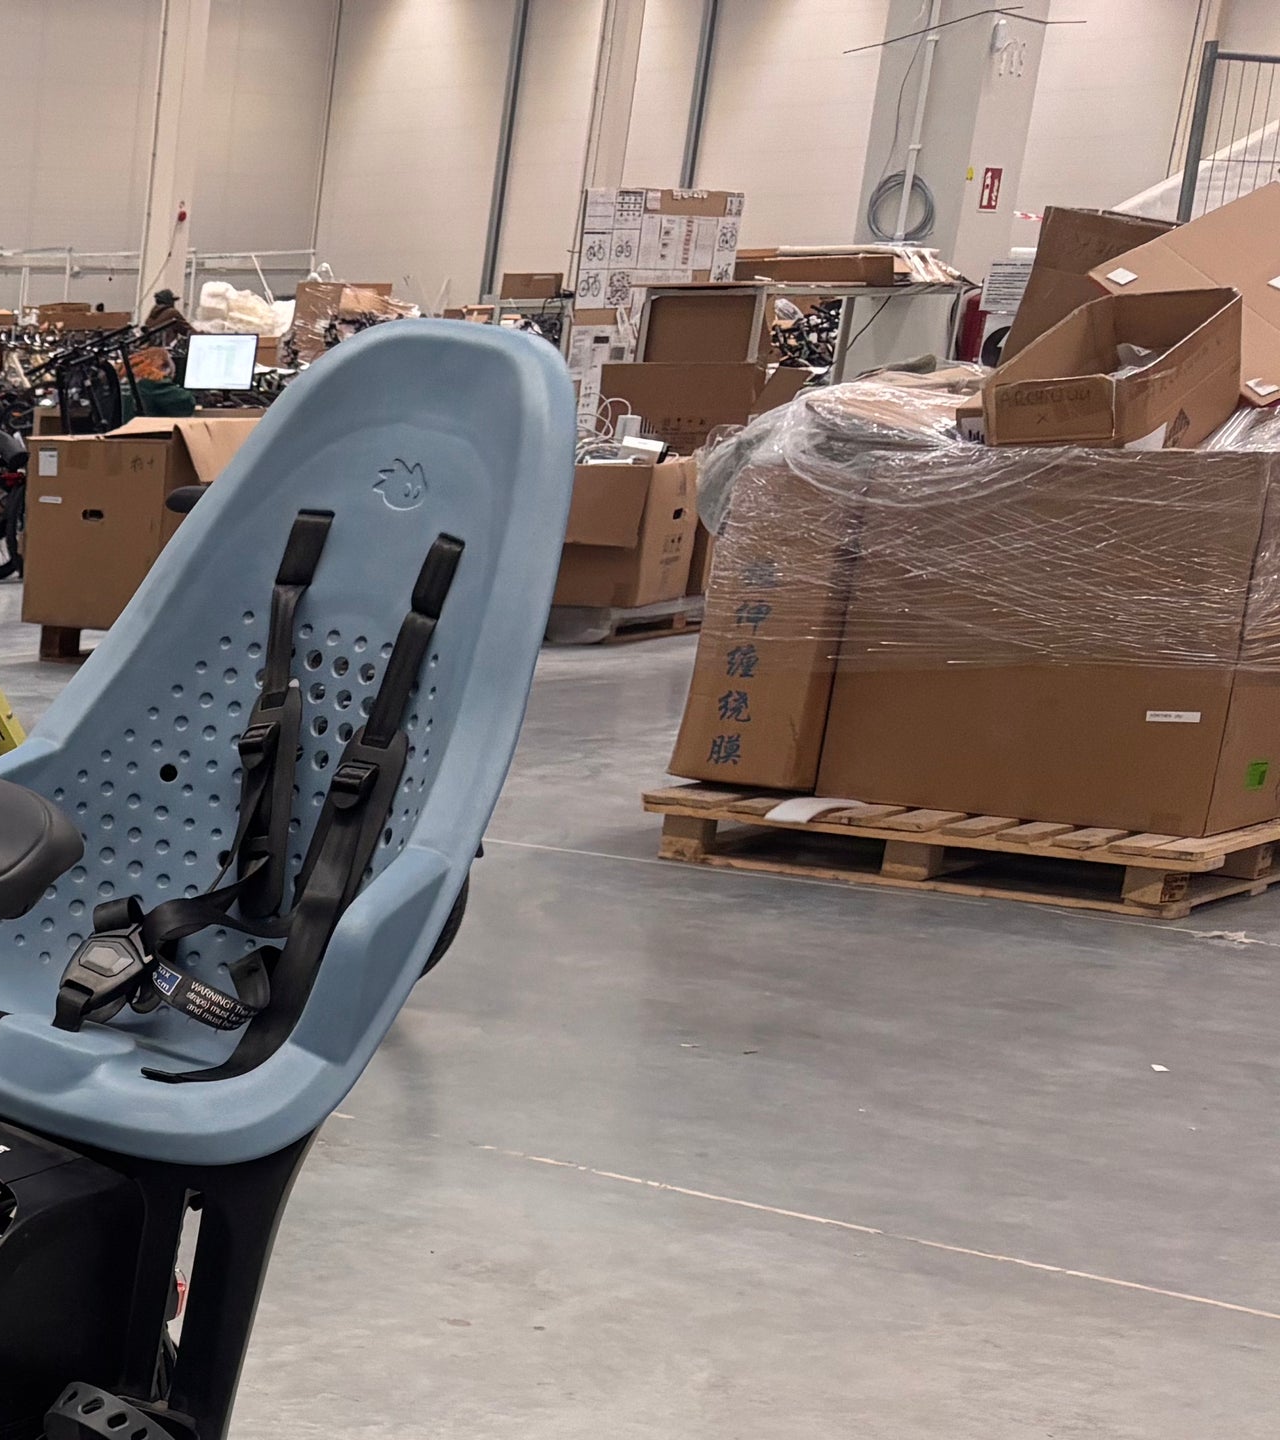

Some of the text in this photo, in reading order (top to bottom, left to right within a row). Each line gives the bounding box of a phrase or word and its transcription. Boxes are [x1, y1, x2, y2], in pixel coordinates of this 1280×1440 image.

[158, 965, 171, 979] ax
[156, 979, 170, 991] cm
[190, 981, 235, 1010] WARNING!
[185, 991, 211, 1010] straps)
[210, 1005, 230, 1018] must
[186, 1003, 204, 1016] and
[202, 1012, 223, 1026] must
